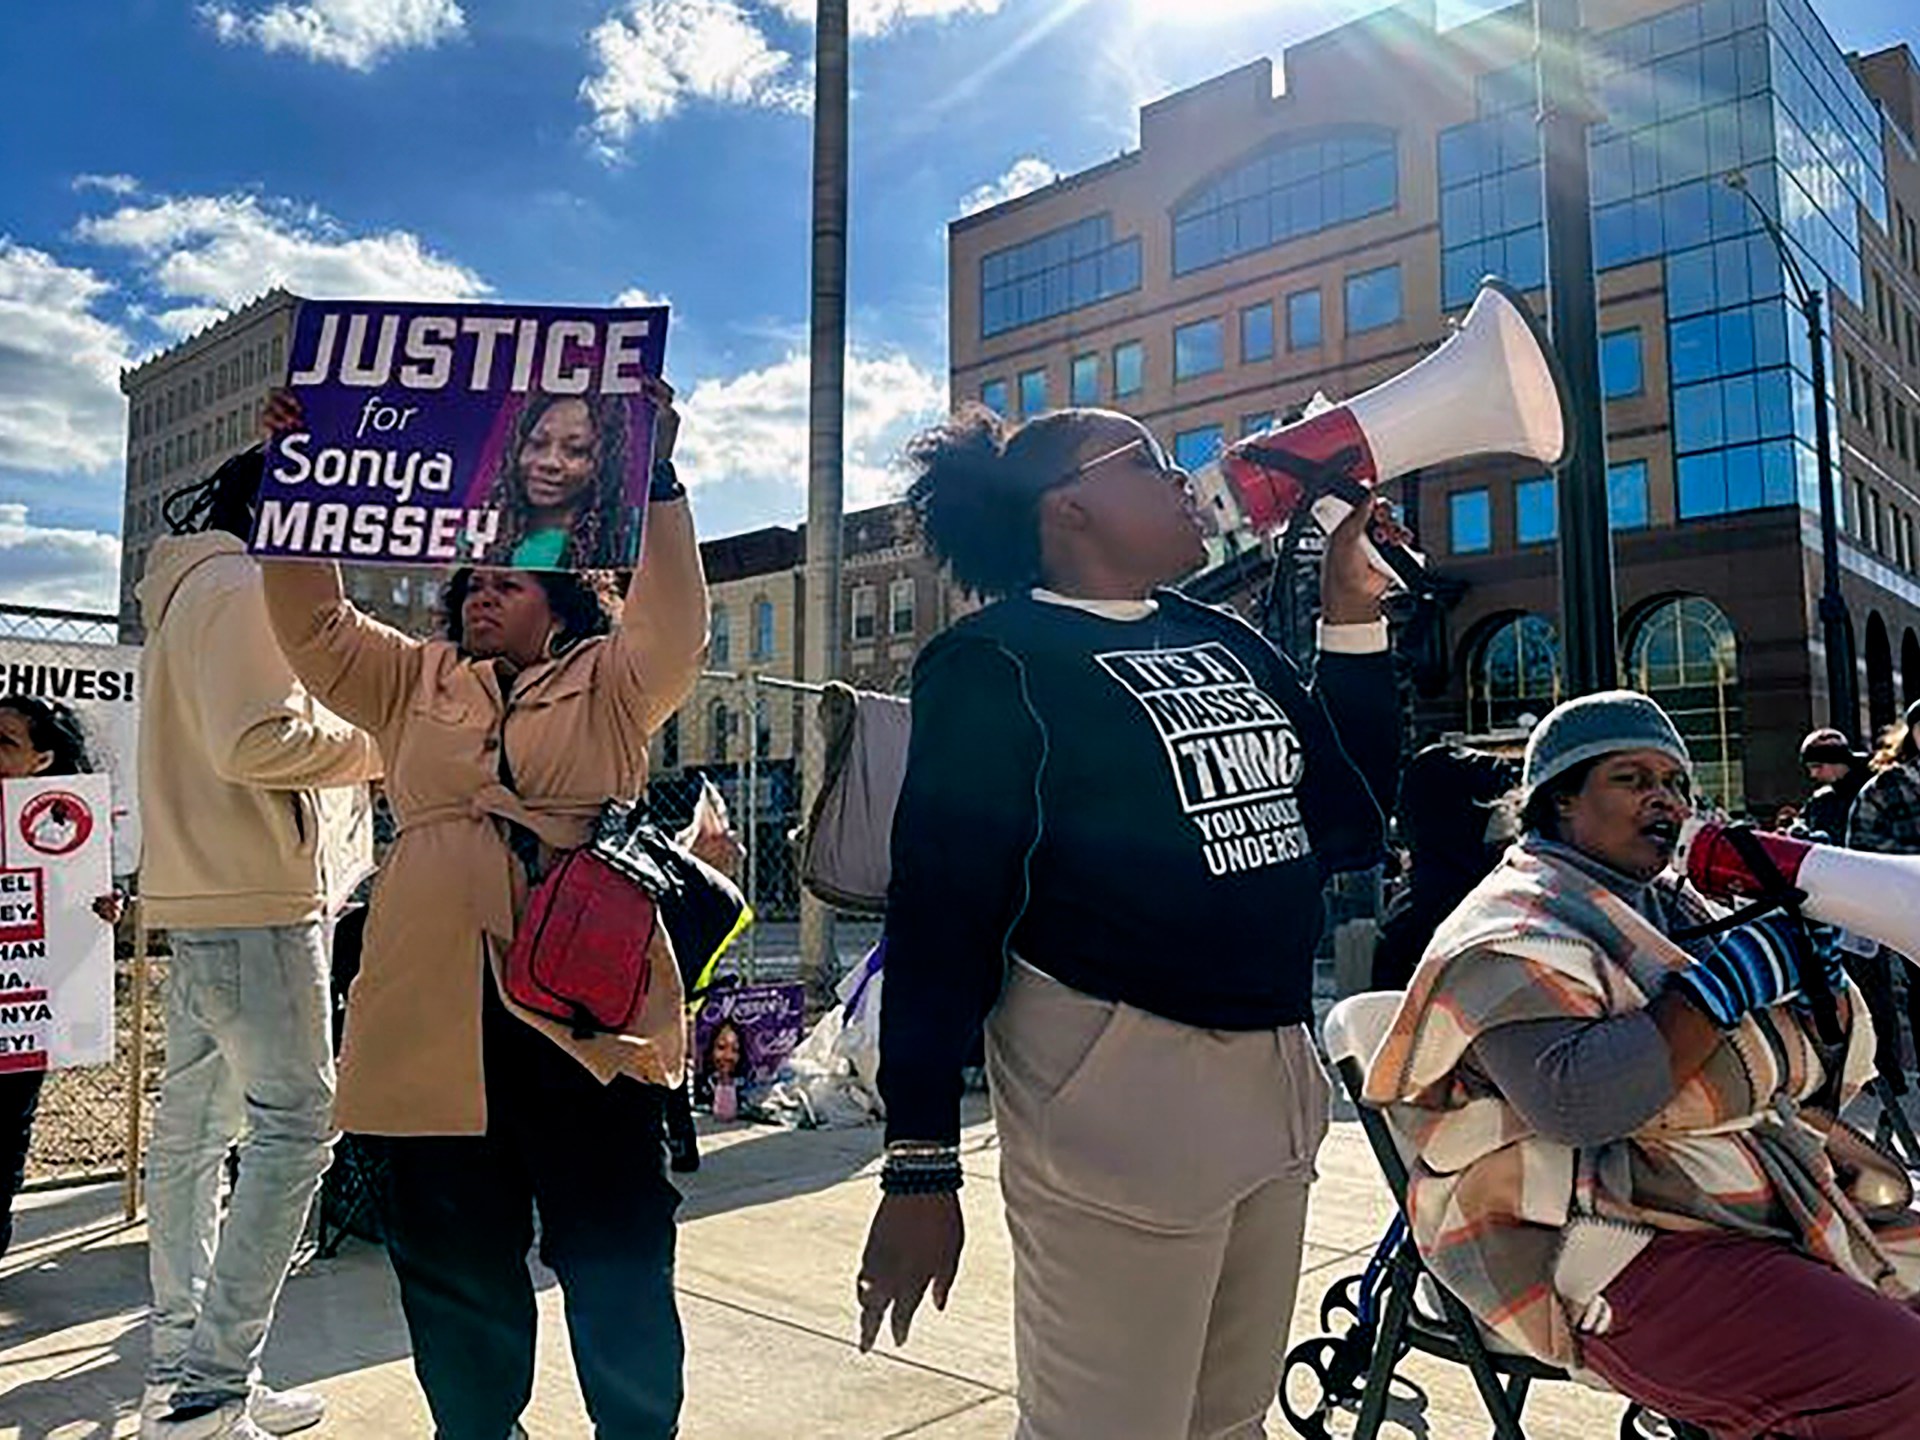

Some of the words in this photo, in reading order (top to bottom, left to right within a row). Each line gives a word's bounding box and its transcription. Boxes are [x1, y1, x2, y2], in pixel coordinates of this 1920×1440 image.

[290, 313, 650, 395] JUSTICE
[356, 396, 418, 437] for
[273, 432, 453, 502] Sonya
[254, 500, 500, 559] MASSEY
[1124, 652, 1206, 688] IT'S
[1192, 651, 1236, 682] A
[1178, 729, 1305, 799] THING
[1193, 808, 1247, 841] YOU
[1, 1004, 52, 1023] NYA
